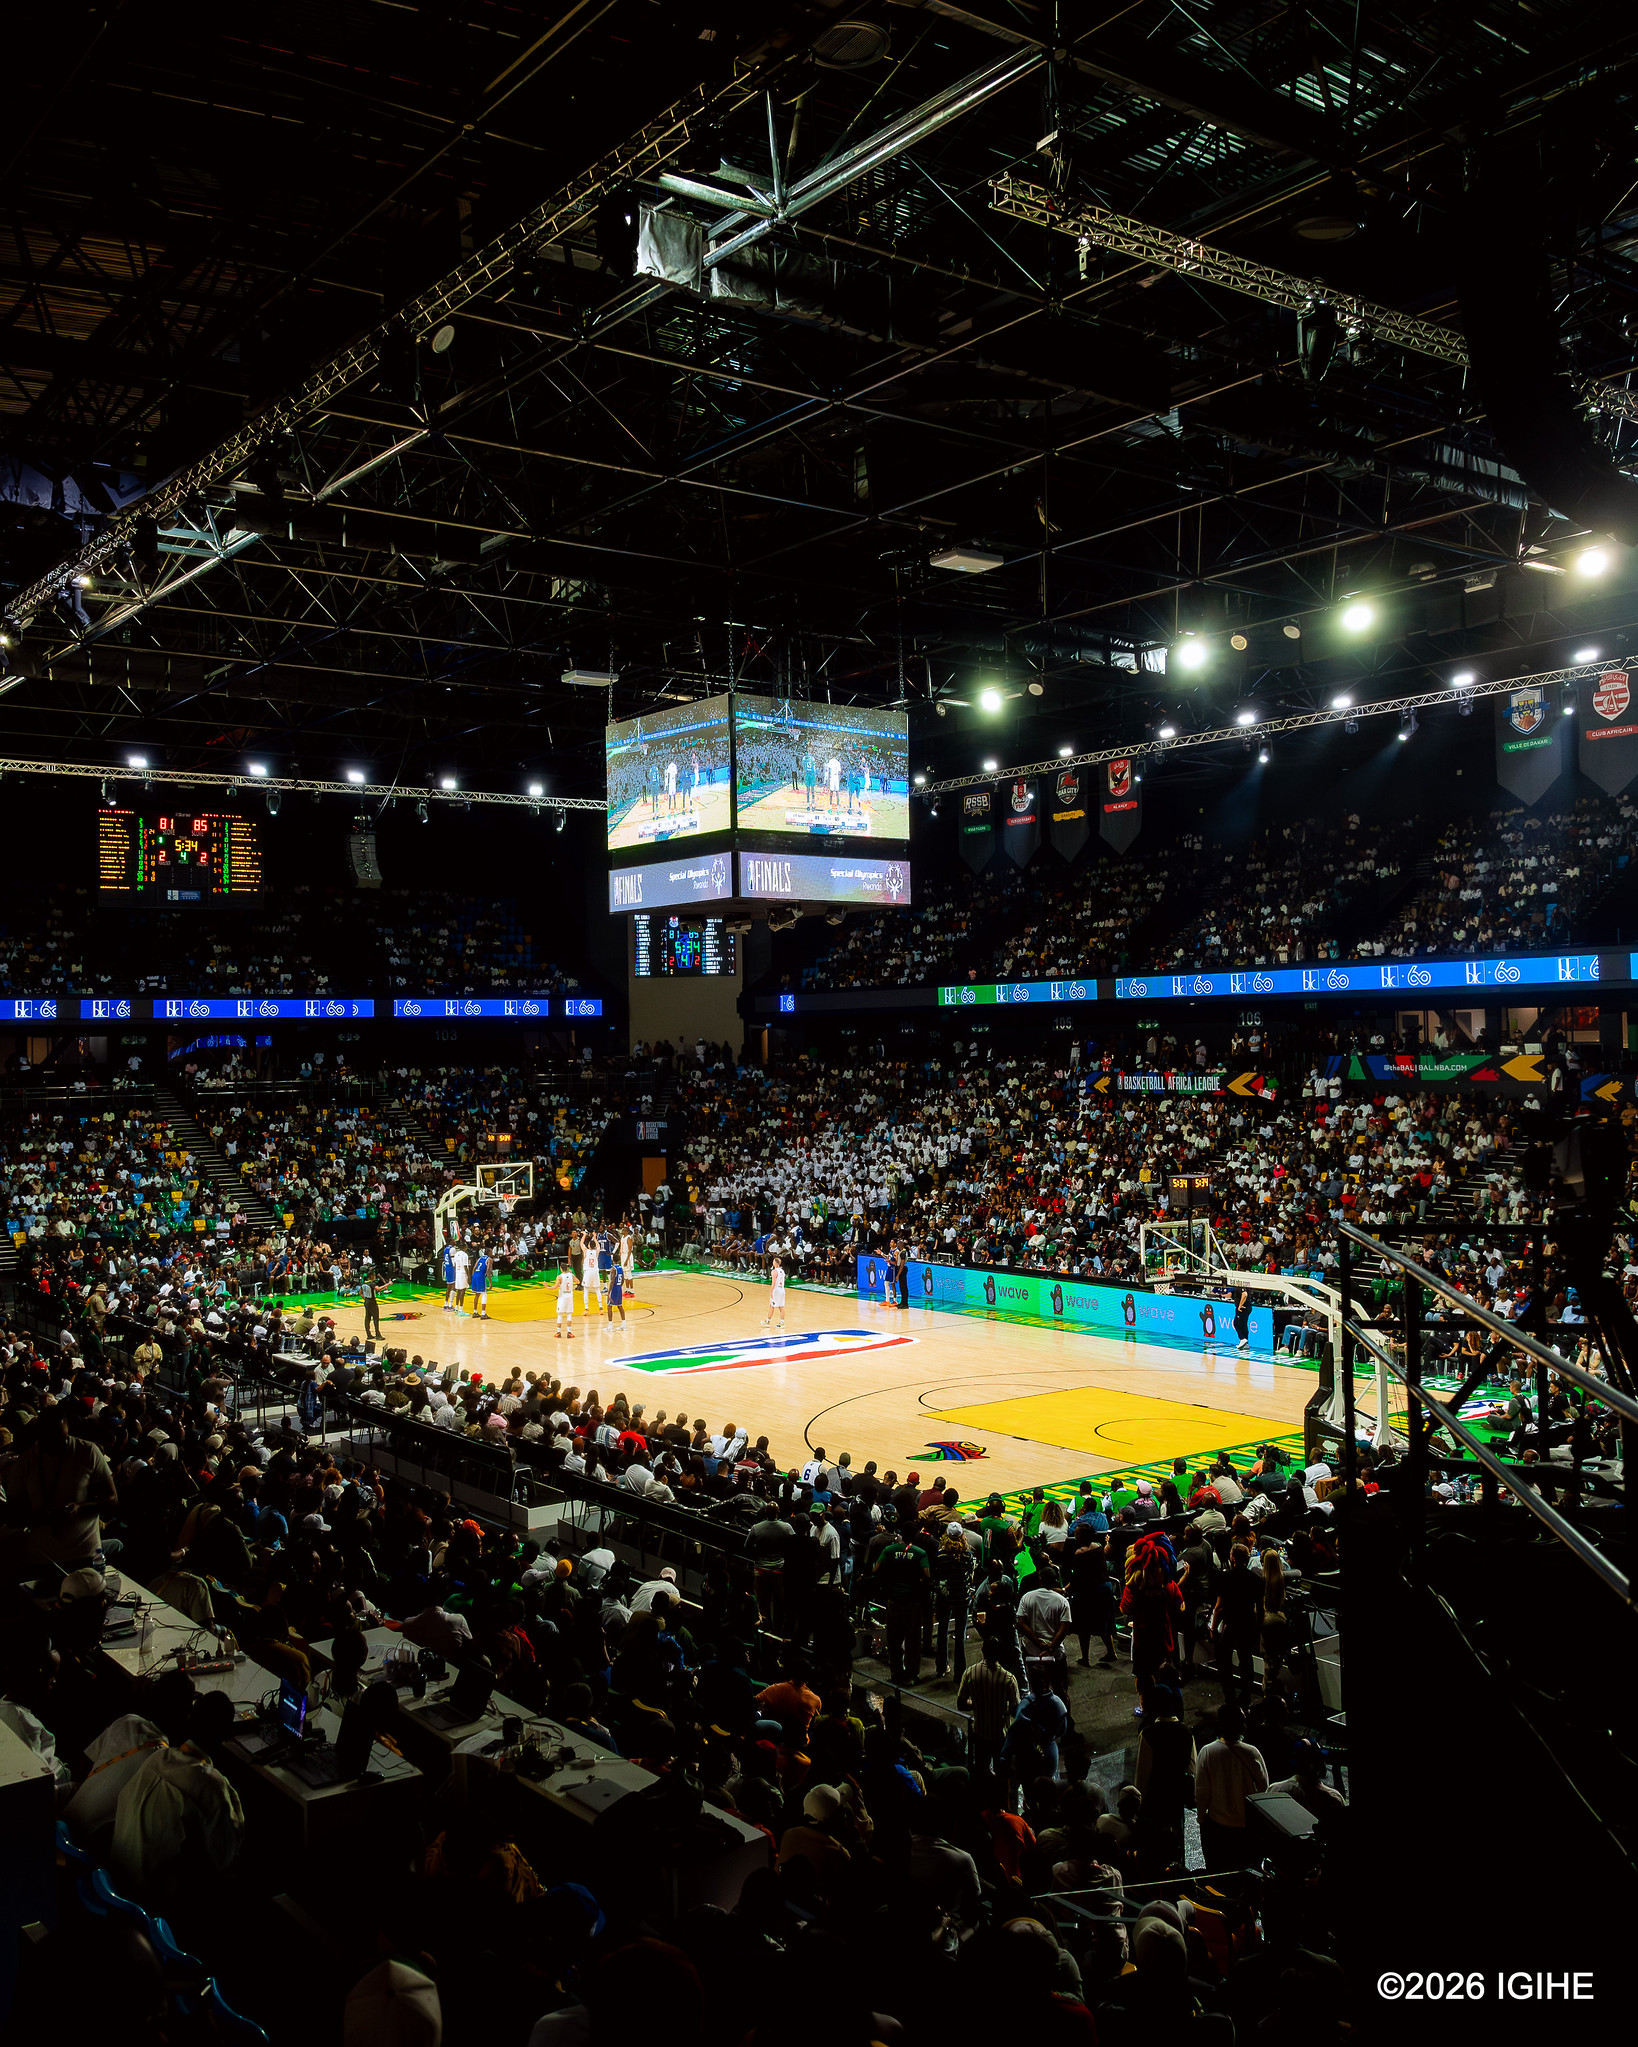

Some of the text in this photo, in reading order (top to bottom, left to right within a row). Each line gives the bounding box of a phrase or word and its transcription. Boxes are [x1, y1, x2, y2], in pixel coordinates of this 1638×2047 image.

[1606, 727, 1633, 736] AFRICAIN
[1530, 739, 1548, 747] DAKAR
[966, 796, 988, 808] RSSB
[160, 818, 174, 829] 81
[194, 820, 207, 831] 85
[174, 840, 198, 852] 5:34
[158, 850, 166, 861] 2
[180, 852, 186, 860] 4
[200, 852, 207, 862] 2
[669, 868, 709, 882] Special Olympics
[756, 860, 791, 892] FINALS
[830, 868, 883, 880] Special Olympics
[620, 874, 642, 904] FINALS
[693, 880, 708, 890] Rwanda
[862, 882, 882, 891] Rwanda
[675, 941, 700, 954] 5:34
[669, 956, 674, 965] 2
[681, 955, 688, 966] 4
[695, 956, 700, 965] 2
[1054, 1017, 1072, 1029] 105
[1239, 1012, 1261, 1025] 106
[436, 1030, 458, 1040] 103
[1124, 1076, 1220, 1091] BASKETBALL AFRICA LEAGUE
[1173, 1179, 1187, 1188] 5:34
[1195, 1178, 1208, 1188] 5:34
[589, 1258, 594, 1267] 12
[936, 1277, 964, 1290] wave
[998, 1286, 1028, 1300] wave
[1066, 1295, 1099, 1310] wave
[1139, 1305, 1175, 1321] wave
[804, 1469, 811, 1480] 6
